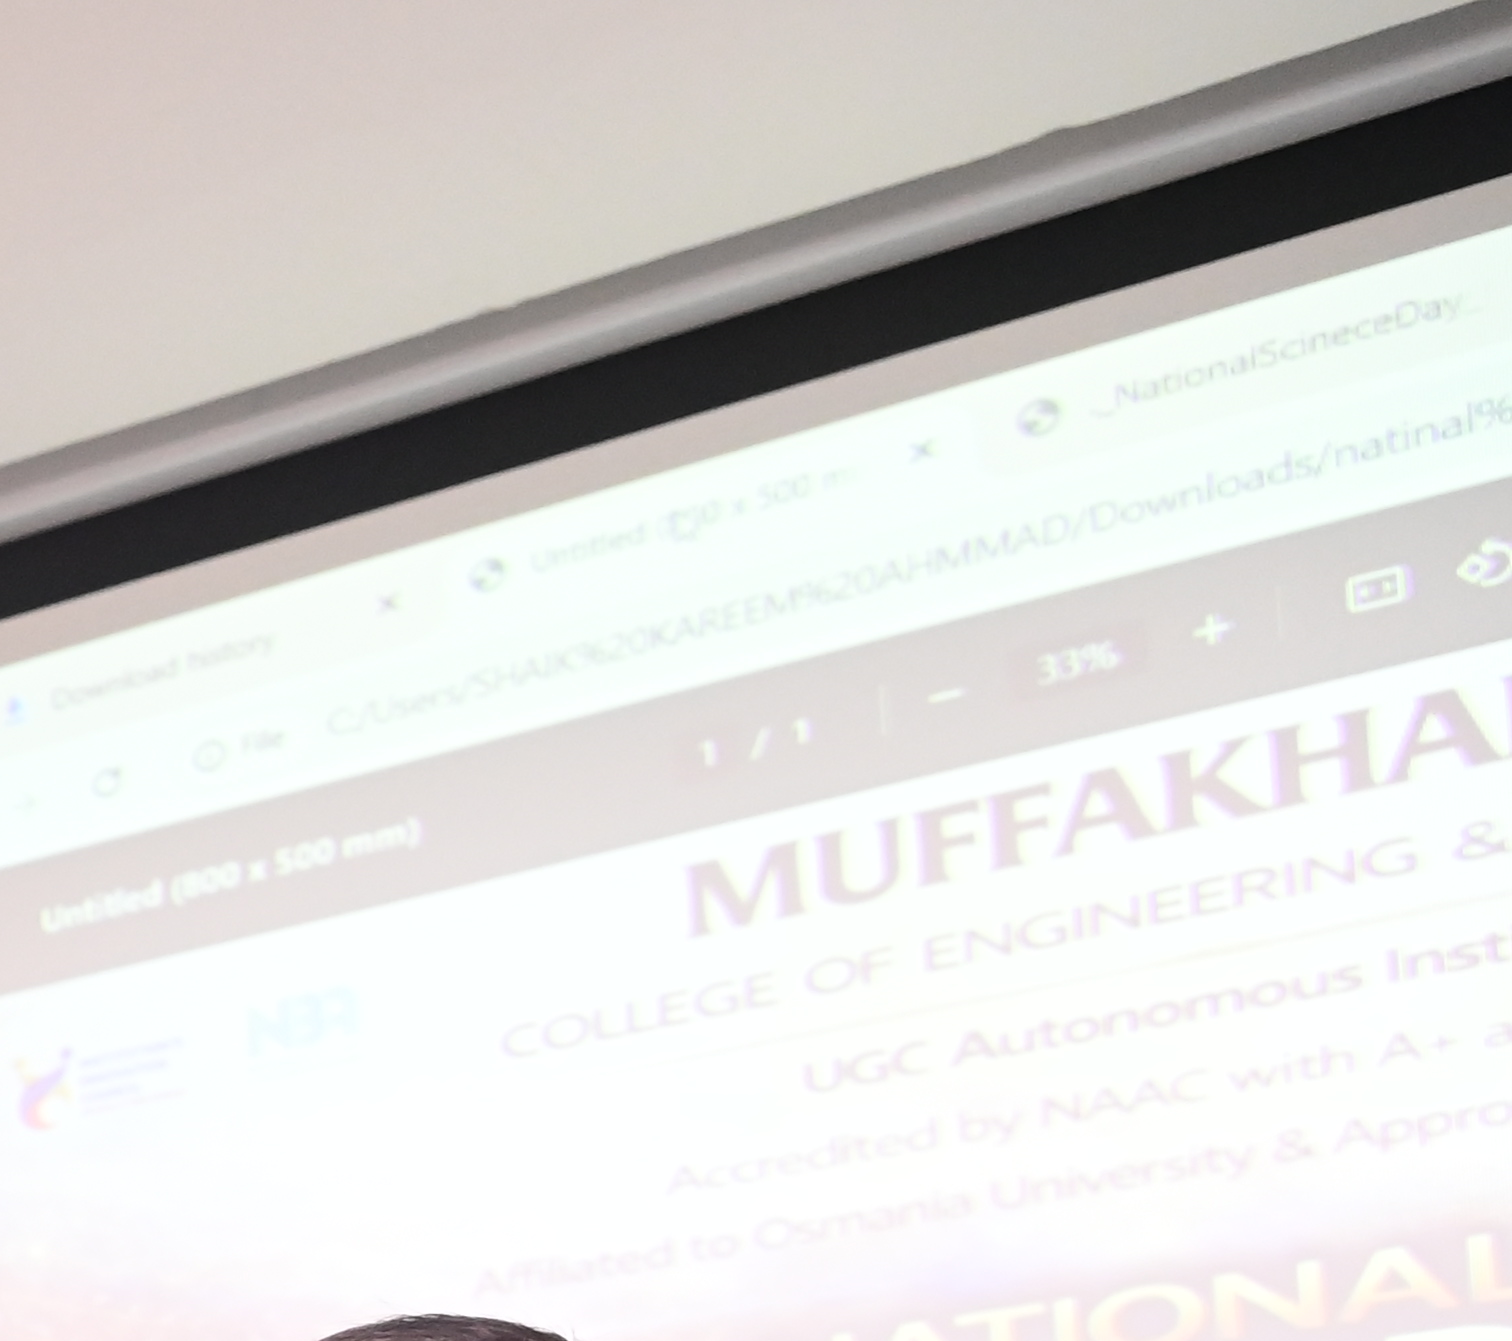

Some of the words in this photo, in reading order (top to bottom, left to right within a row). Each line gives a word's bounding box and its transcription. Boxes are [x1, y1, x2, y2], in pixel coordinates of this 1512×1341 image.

[1037, 641, 1124, 688] 33%
[684, 672, 1512, 940] MUFFAKHA
[697, 738, 718, 768] 1
[791, 719, 811, 747] 1
[40, 880, 166, 935] Untitled
[275, 836, 336, 878] 500
[500, 971, 779, 1061] COLLEGE
[804, 946, 894, 998] OF
[920, 834, 1420, 975] ENGINEERING
[1451, 816, 1510, 864] &
[802, 1038, 931, 1095] UGC
[950, 959, 1365, 1067] Autonomous
[1385, 929, 1512, 987] Inst
[664, 1115, 941, 1198] Accredited
[956, 1100, 1022, 1148] by
[1037, 1067, 1211, 1130] NAAC
[1226, 1043, 1358, 1095] with
[1378, 1030, 1460, 1070] A+
[689, 1232, 743, 1262] to
[752, 1188, 974, 1252] Osmania
[986, 1137, 1257, 1219] University
[1271, 1128, 1314, 1166] &
